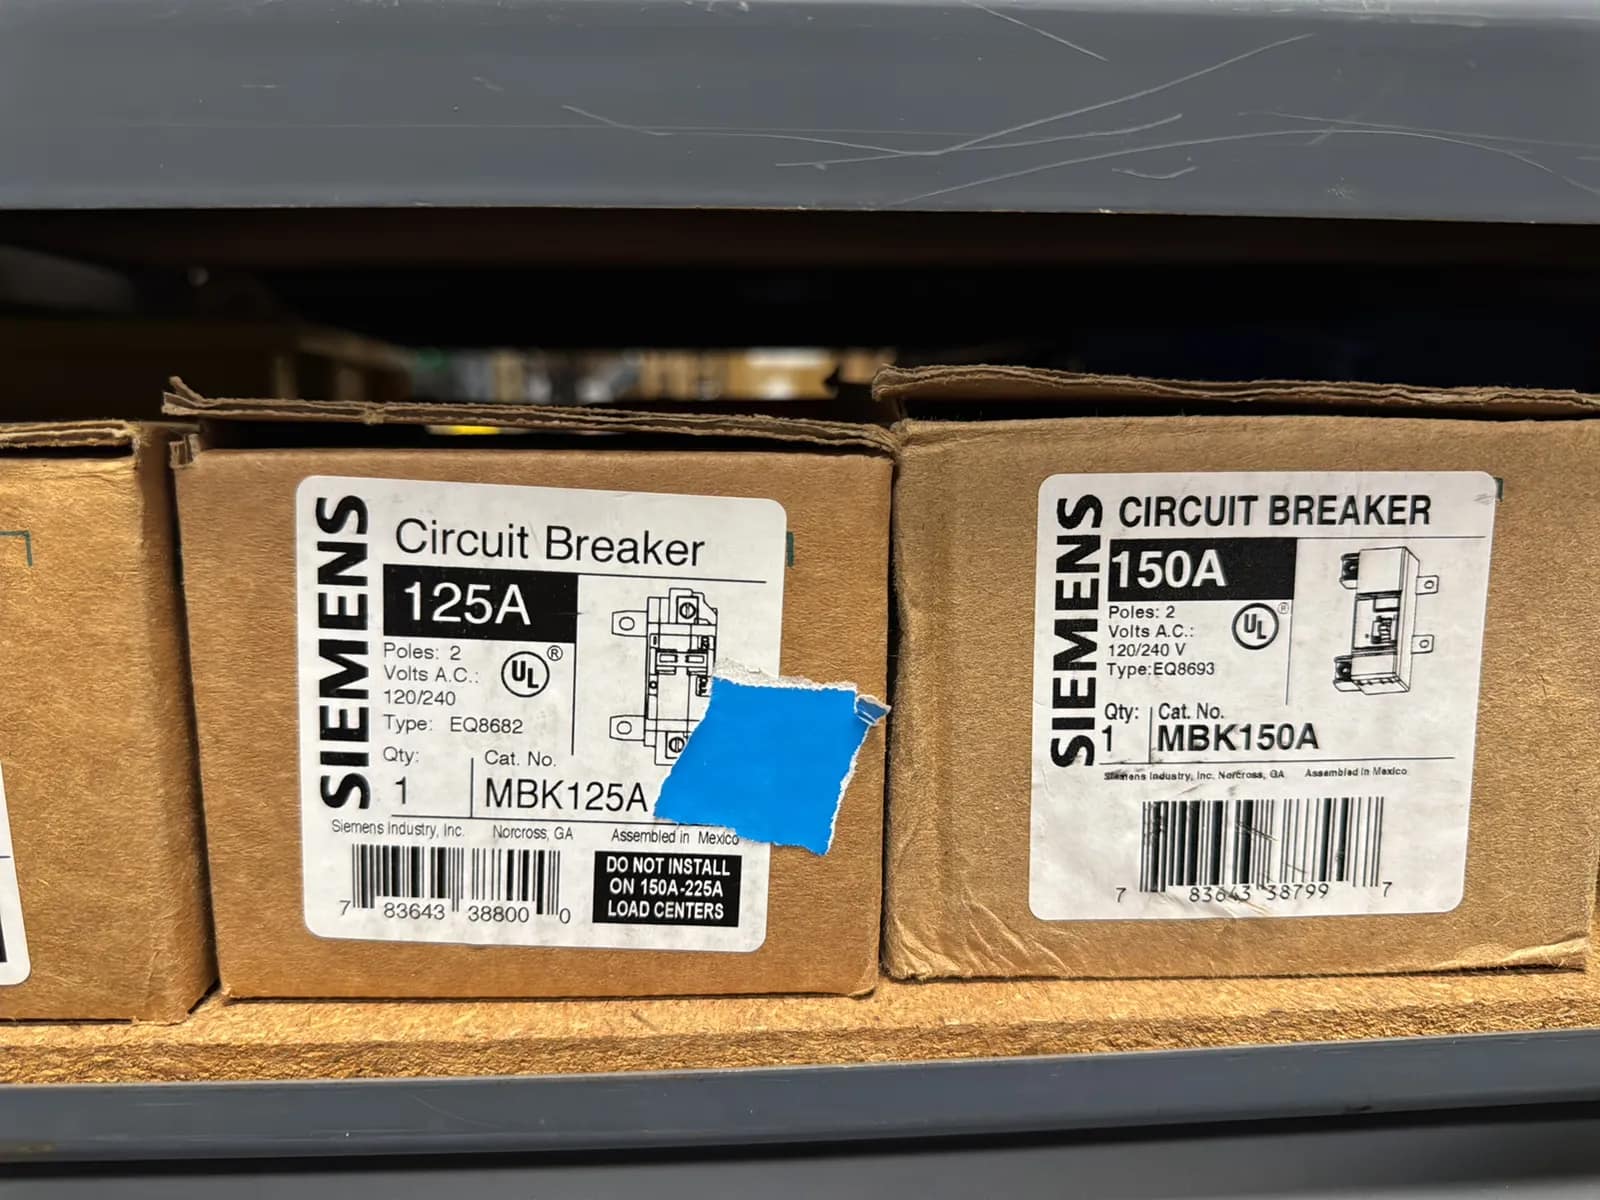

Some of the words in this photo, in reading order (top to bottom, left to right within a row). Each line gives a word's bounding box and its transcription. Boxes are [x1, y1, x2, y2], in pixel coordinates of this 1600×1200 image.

[1119, 495, 1258, 527] CIRCUIT
[1269, 494, 1431, 526] BREAKER
[396, 518, 529, 559] Circuit
[546, 525, 705, 567] Breaker
[1111, 549, 1227, 588] 150A
[404, 581, 531, 625] 125A
[1108, 605, 1159, 618] Poles:
[1166, 606, 1175, 618] 2
[1050, 494, 1103, 767] SIEMENS
[1109, 624, 1149, 638] Volts
[1156, 625, 1194, 638] A.C.:
[315, 495, 370, 809] SIEMENS
[383, 642, 439, 661] Poles:
[450, 645, 461, 661] 2
[1109, 643, 1170, 657] 120/240
[1175, 643, 1186, 656] V
[383, 665, 428, 682] Volts
[434, 667, 479, 684] A.C.:
[384, 689, 456, 706] 120/240
[1104, 703, 1139, 723] Qty:
[1158, 702, 1192, 720] Cat.
[1196, 702, 1225, 720] No.
[384, 714, 432, 734] Type:
[450, 716, 523, 734] EQ8682
[1101, 726, 1113, 751] 1
[1157, 722, 1319, 752] MBK150A
[383, 746, 419, 767] Qty:
[485, 750, 520, 766] Cat.
[527, 752, 557, 767] No.
[1150, 771, 1194, 782] Industry,
[1305, 768, 1359, 777] Assembled
[1361, 767, 1370, 776] in
[1373, 766, 1407, 776] Mexico
[395, 776, 406, 804] 1
[485, 777, 648, 812] MBK125A
[332, 819, 384, 835] Siemens
[388, 821, 440, 838] Industry,
[443, 823, 465, 837] Inc.
[492, 825, 550, 842] Norcross,
[554, 825, 573, 840] GA
[611, 828, 676, 843] Assembled
[680, 830, 690, 844] in
[698, 831, 740, 846] Mexico
[606, 856, 629, 873] DO
[633, 857, 665, 875] NOT
[668, 858, 730, 877] INSTALL
[609, 877, 634, 894] ON
[640, 879, 723, 898] 150A-225A
[1115, 887, 1127, 903] 7
[1189, 884, 1251, 902] 83643
[1267, 883, 1329, 900] 38799
[1382, 881, 1393, 897] 7
[339, 900, 351, 916] 7
[384, 902, 445, 920] 83643
[468, 905, 530, 923] 38800
[559, 908, 571, 924] 0
[608, 900, 649, 918] LOAD
[654, 901, 724, 920] CENTERS
